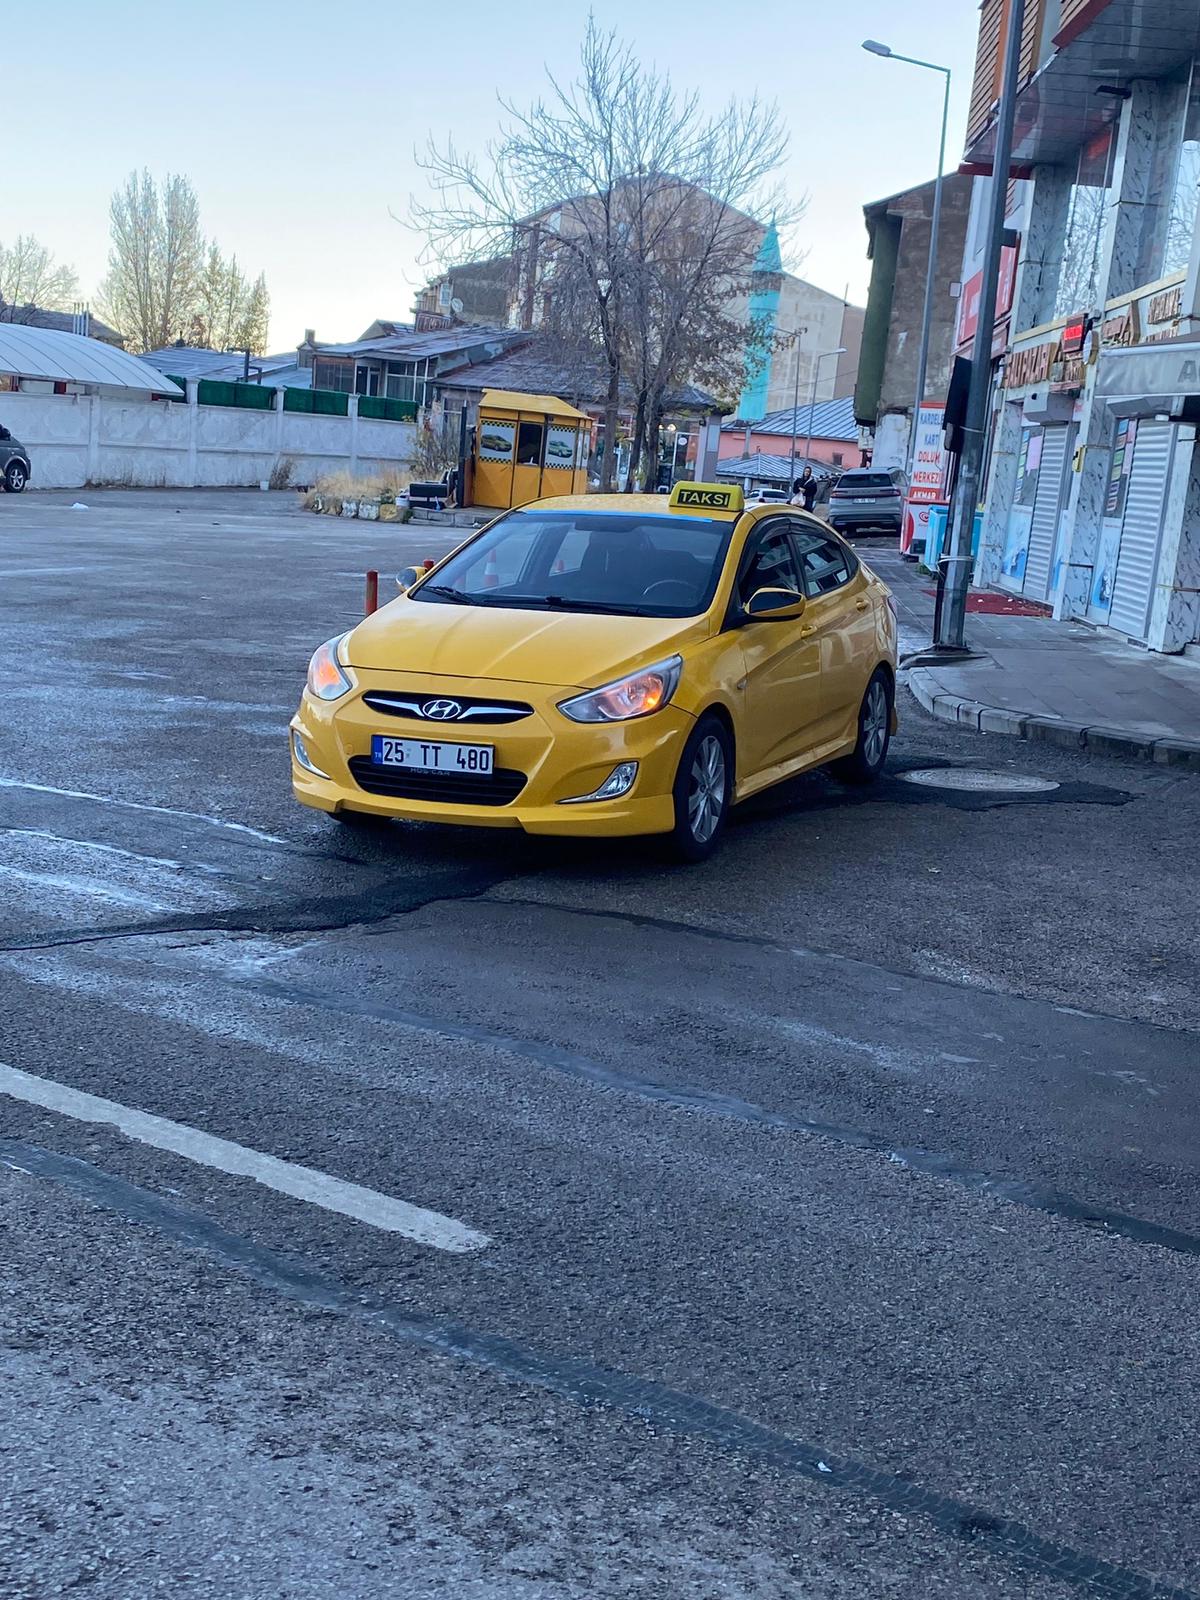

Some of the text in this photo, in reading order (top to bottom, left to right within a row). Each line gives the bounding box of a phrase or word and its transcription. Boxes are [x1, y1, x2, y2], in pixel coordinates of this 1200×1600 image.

[919, 413, 944, 425] KARDELE
[923, 434, 940, 447] KART
[917, 451, 940, 464] DOLUM
[384, 741, 490, 771] 25 TT 480
